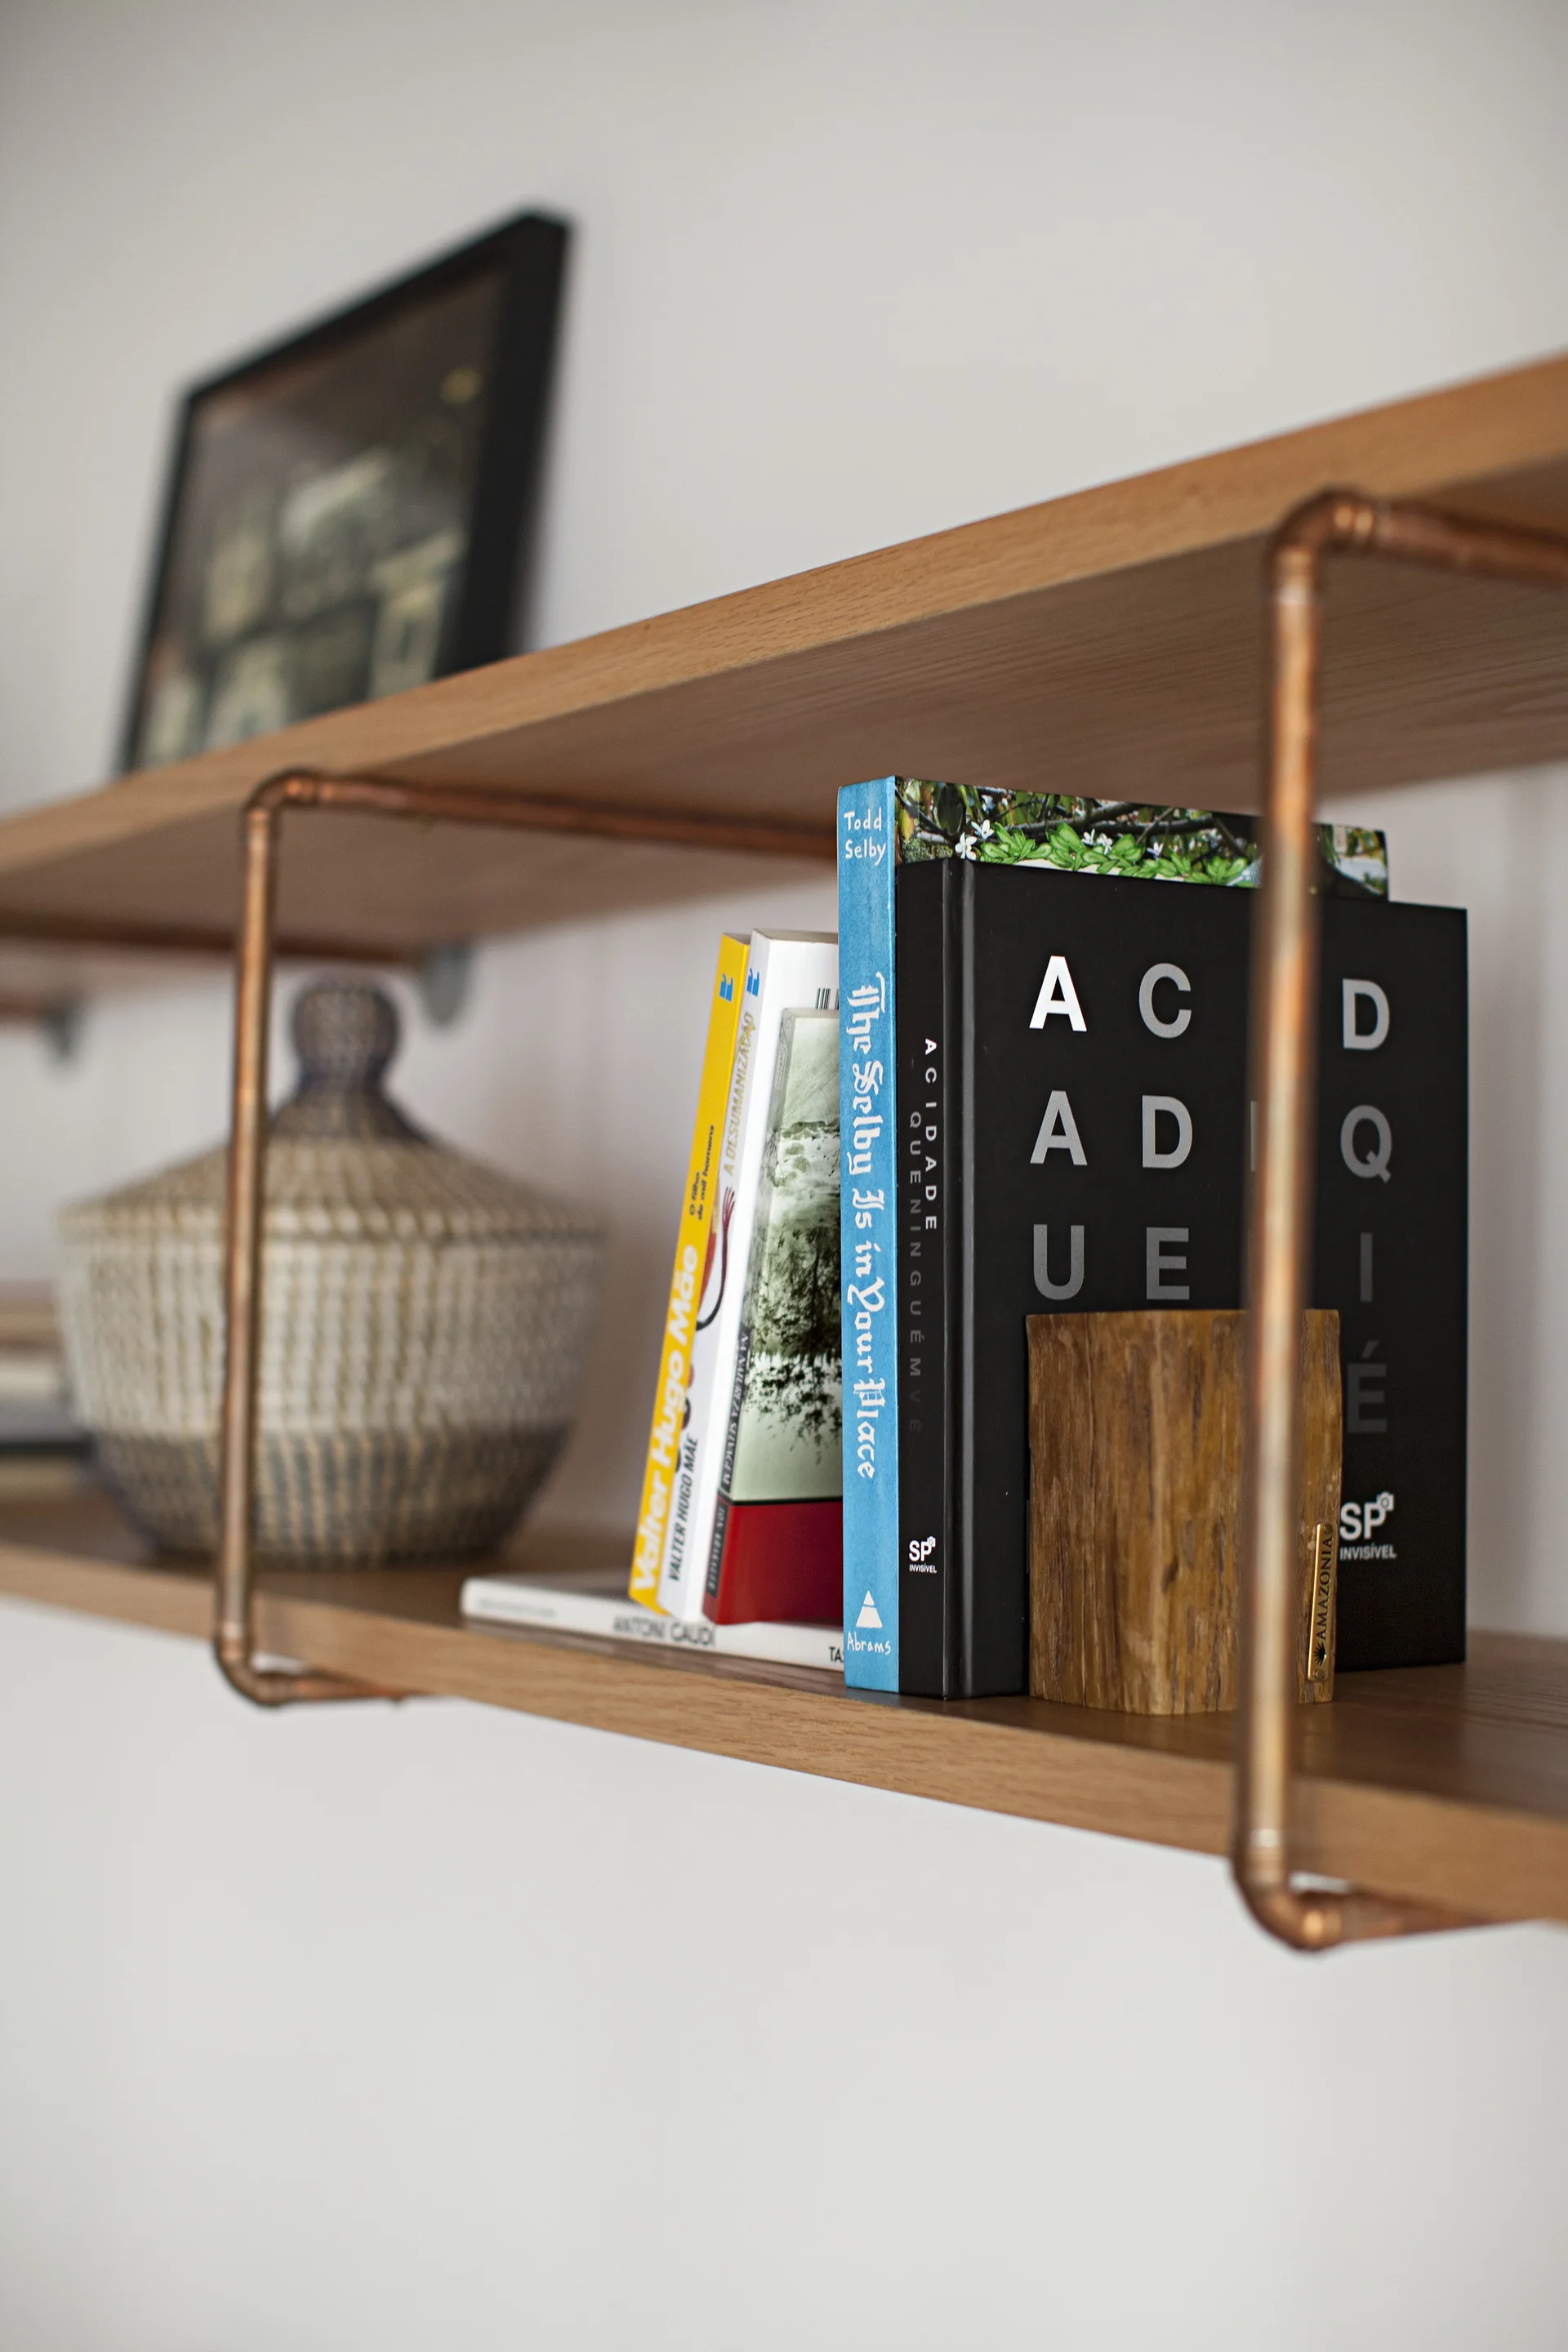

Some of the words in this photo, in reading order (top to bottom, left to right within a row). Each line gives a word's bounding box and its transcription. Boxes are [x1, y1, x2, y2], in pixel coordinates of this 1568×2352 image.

[844, 807, 882, 831] Todd
[845, 838, 886, 866] Selby
[846, 971, 885, 1054] The
[847, 1060, 884, 1175] Selby
[853, 1187, 884, 1228] Is
[855, 1240, 881, 1278] in
[847, 1276, 885, 1374] Your
[635, 1469, 670, 1592] Valter
[653, 1349, 686, 1468] Hugo
[853, 1378, 886, 1479] Place
[668, 1521, 687, 1583] VALTER
[678, 1472, 693, 1522] HUGO
[1316, 1535, 1334, 1642] AMAZONIA
[847, 1630, 891, 1655] Abrams
